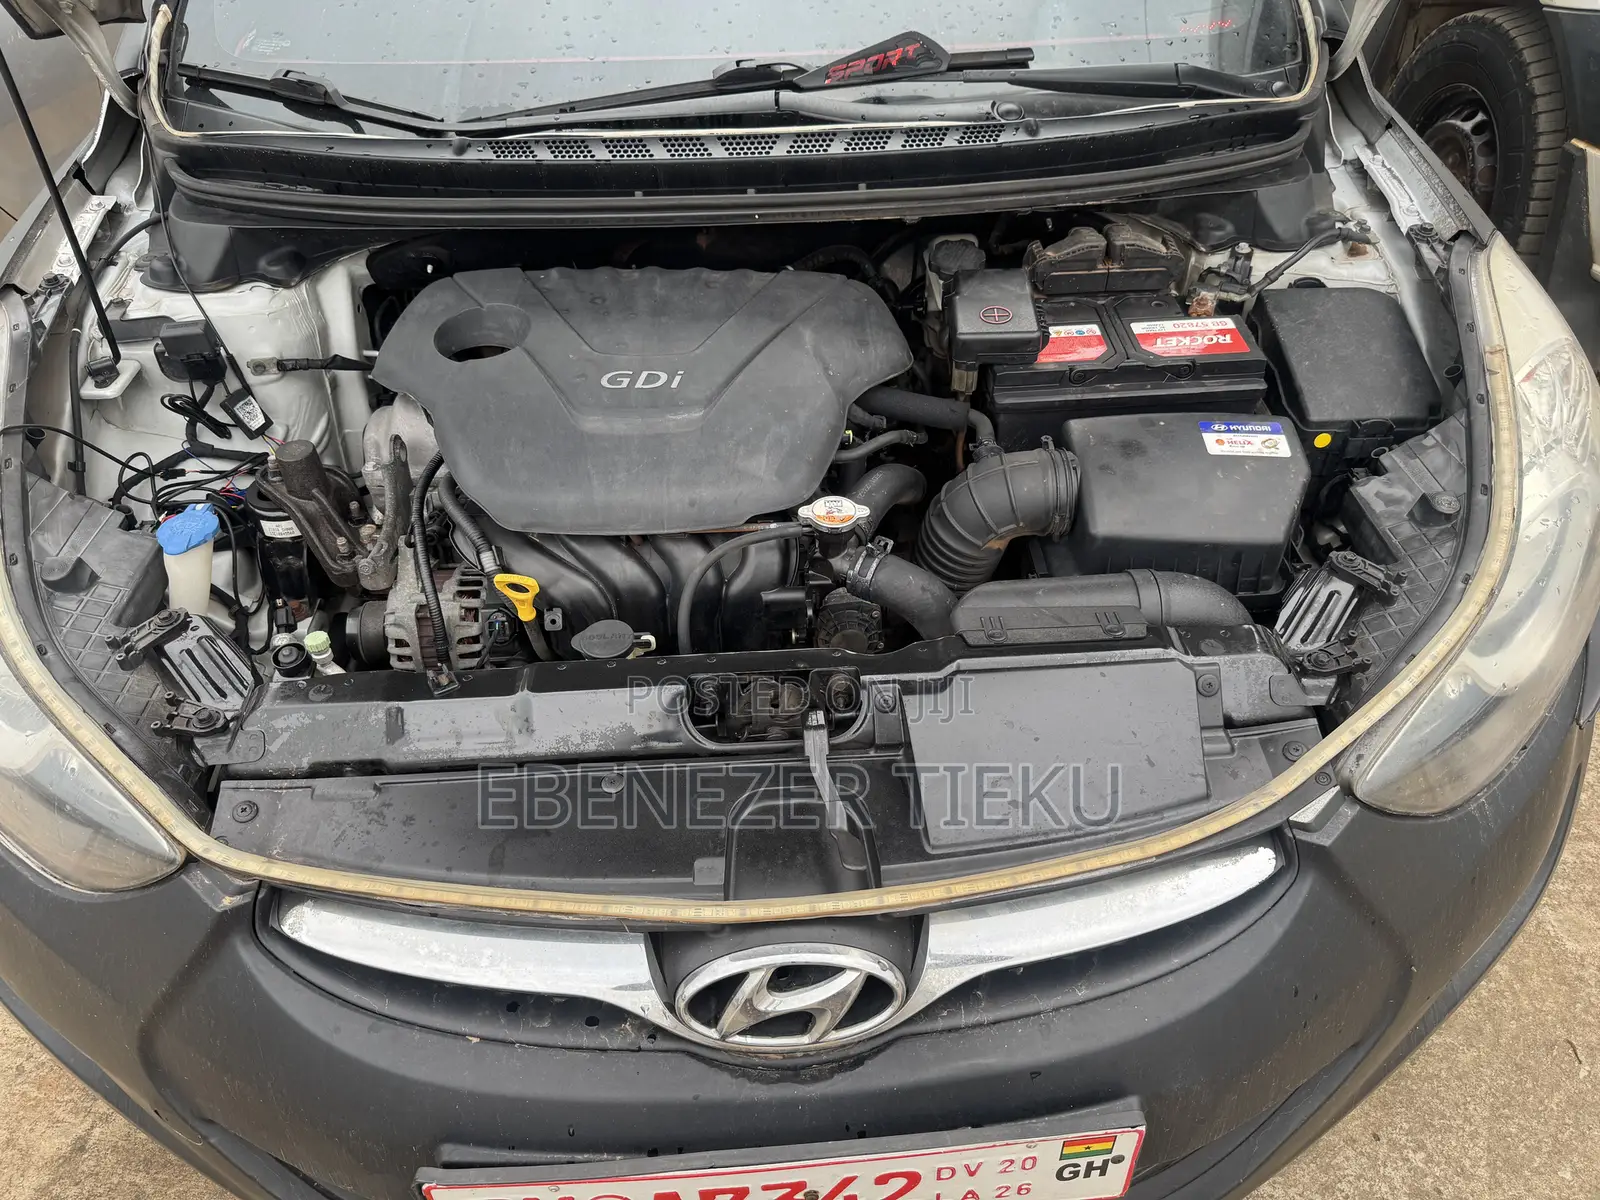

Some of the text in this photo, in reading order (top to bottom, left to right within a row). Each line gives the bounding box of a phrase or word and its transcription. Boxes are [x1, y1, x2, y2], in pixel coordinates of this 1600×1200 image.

[824, 42, 921, 84] SPORT
[1153, 333, 1233, 348] ROCKET
[600, 370, 685, 389] GDi
[1229, 424, 1272, 432] HYUNDAI
[935, 1155, 1039, 1181] DV 20
[1055, 1158, 1112, 1182] GH
[994, 1182, 1033, 1199] 26
